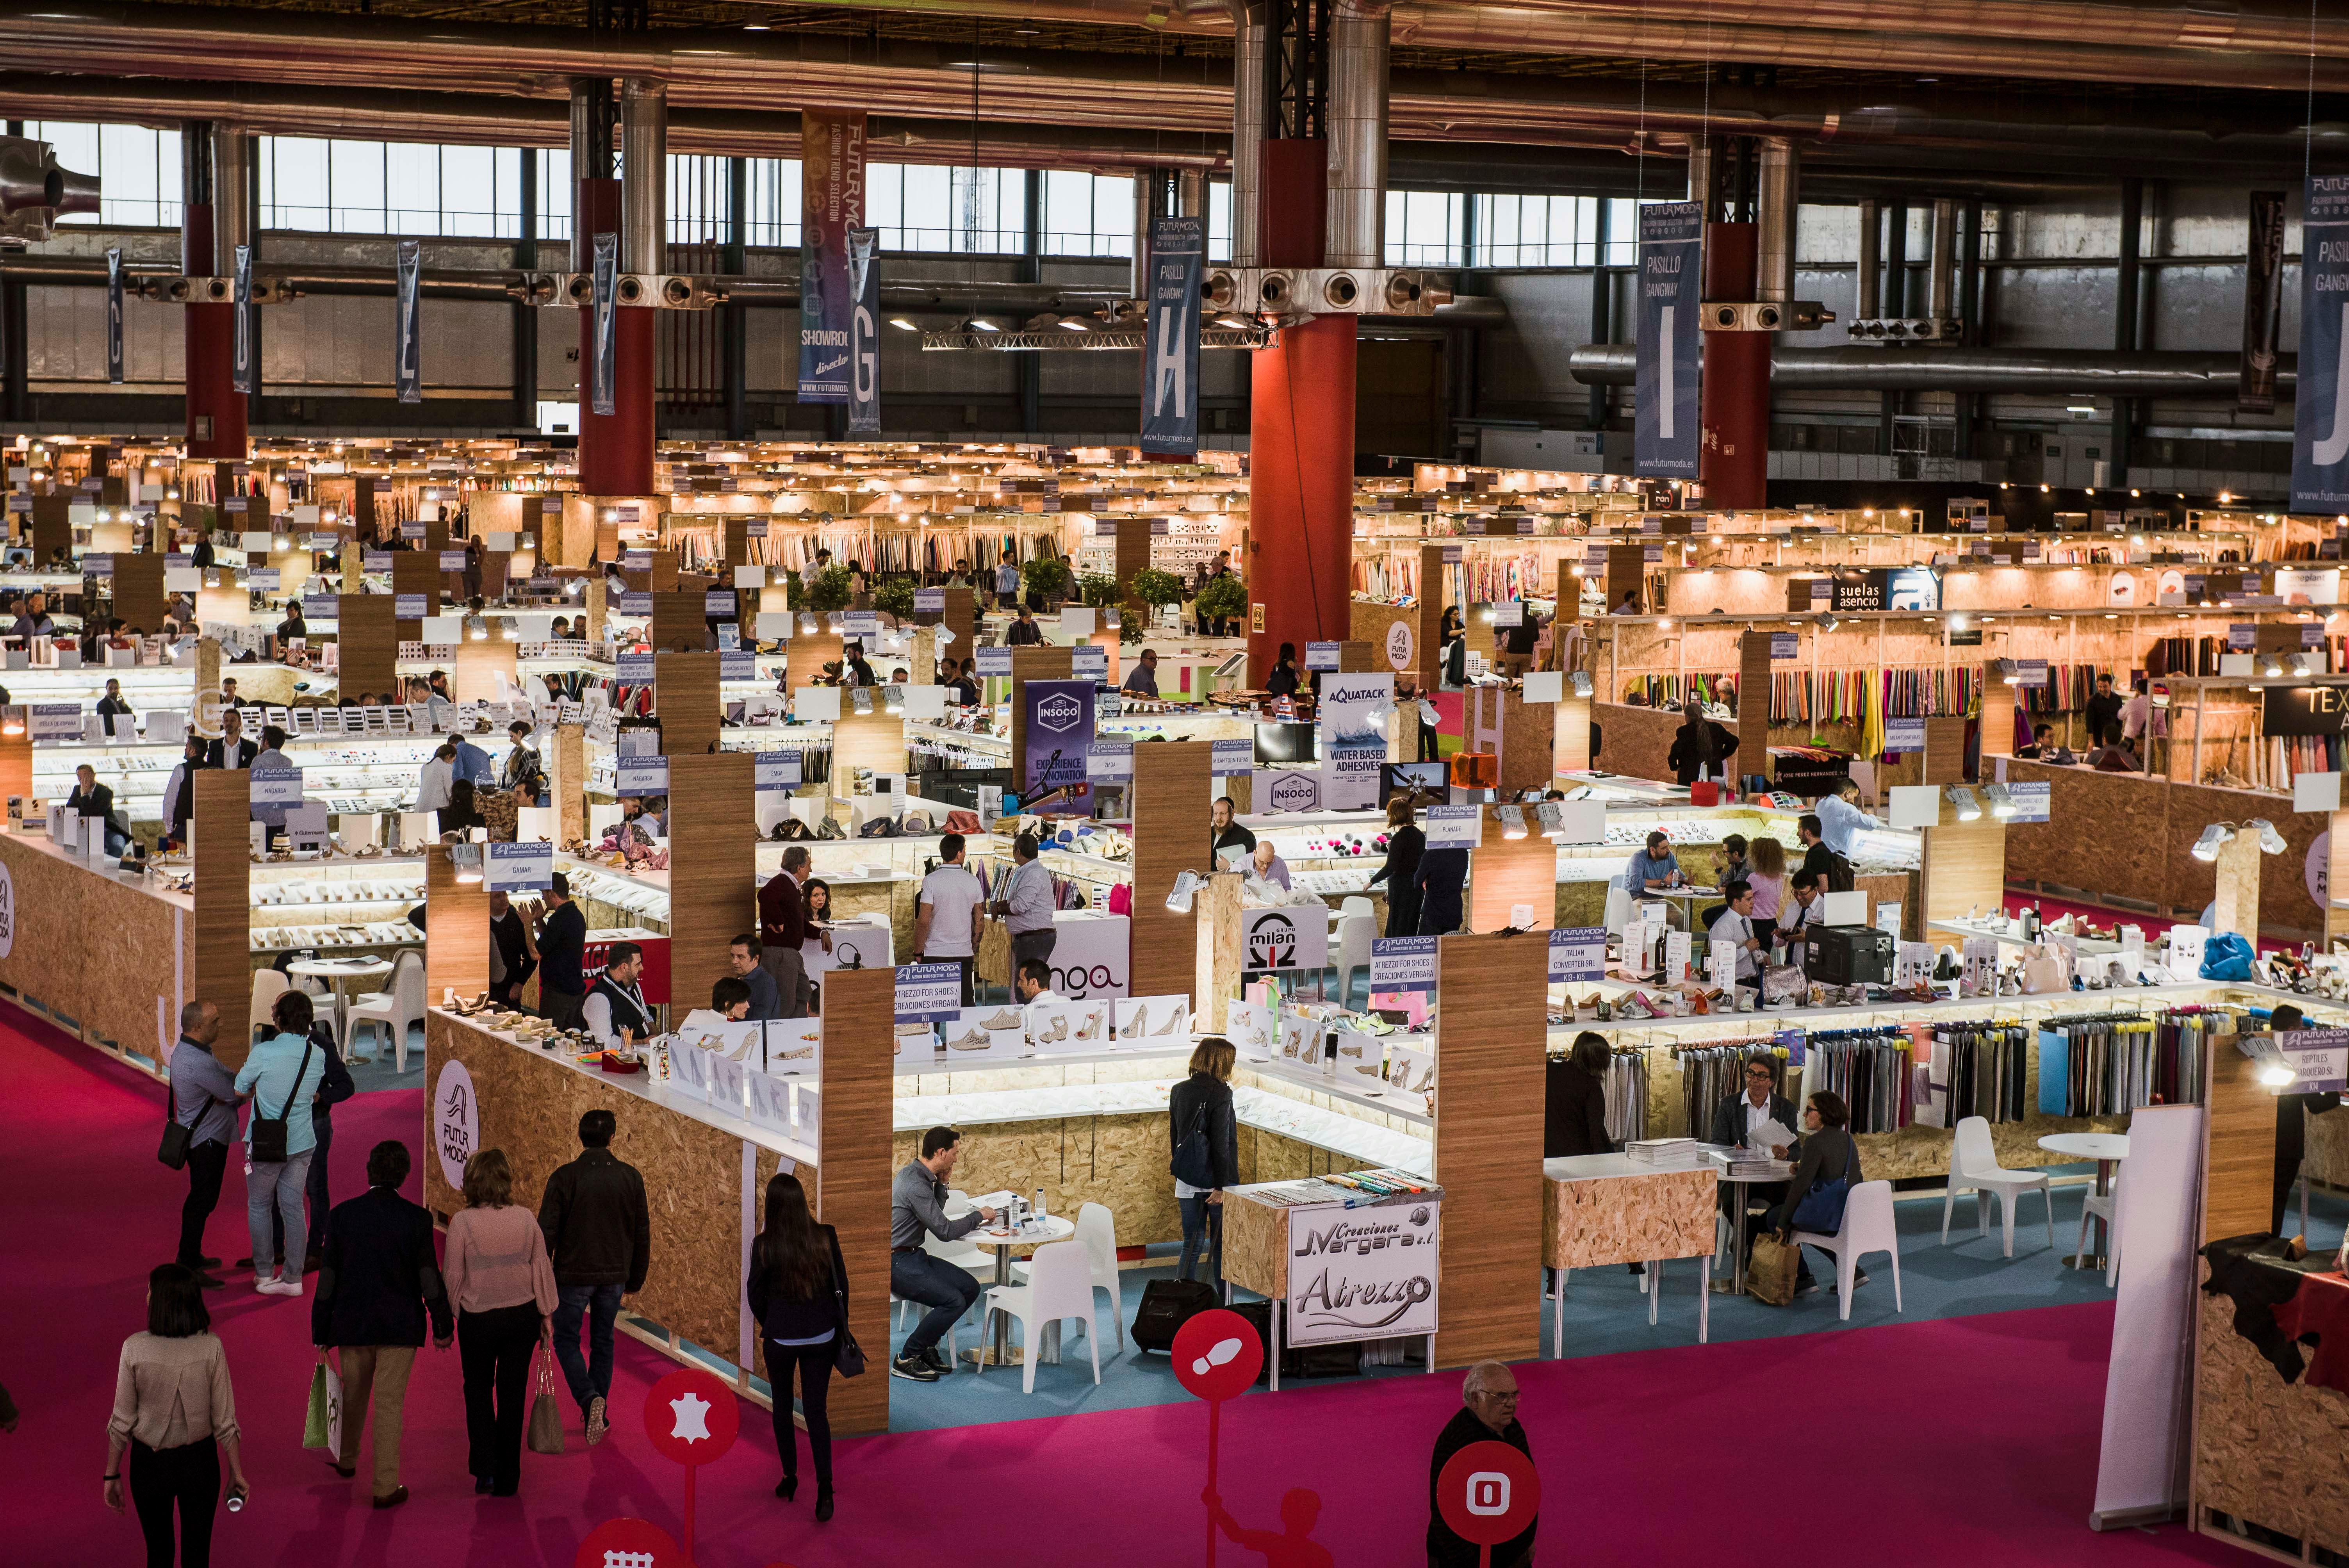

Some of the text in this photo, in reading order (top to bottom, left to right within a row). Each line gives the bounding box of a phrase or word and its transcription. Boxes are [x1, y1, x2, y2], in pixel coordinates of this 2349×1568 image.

[829, 123, 841, 222] FASHION TREND SELECTION
[1644, 204, 1701, 217] FUTURMODA
[1159, 222, 1200, 233] FUTURMODA
[1647, 256, 1681, 274] PASILLO
[1160, 265, 1184, 280] PASILLO
[1158, 287, 1184, 299] GANGWAY
[1646, 283, 1677, 297] GANGWAY
[801, 330, 848, 347] SHOWRO
[854, 306, 874, 402] G
[1154, 306, 1187, 418] H
[1660, 306, 1674, 438] I
[1143, 433, 1193, 443] www.futurmoda.es
[1640, 458, 1694, 468] www.futurmoda.es
[1840, 583, 1879, 596] suelas
[1840, 597, 1878, 606] asencio
[1392, 645, 1407, 654] FUTUR
[1329, 687, 1385, 703] AQUATACK
[1041, 708, 1077, 717] INSOCO
[1330, 750, 1386, 761] WATER BASED
[1036, 758, 1082, 770] EXPERIENCE
[1336, 761, 1381, 772] ADHESIVES
[1274, 789, 1313, 799] INSOCO
[1250, 932, 1296, 945] milan
[1391, 937, 1435, 946] FUTURMODA
[911, 964, 960, 974] FUTURMODA
[1375, 960, 1399, 969] ATREZZO
[1554, 960, 1584, 969] CONVERTER
[1374, 971, 1433, 980] CREACIONES VERGARA
[894, 989, 920, 998] ATREZZO
[935, 987, 954, 996] SHOES
[894, 1000, 958, 1010] CREACIONES VERGARA
[2302, 1030, 2348, 1039] FUTURMODA
[2302, 1054, 2328, 1064] REPTILES
[2327, 1066, 2333, 1075] SL
[444, 1123, 470, 1151] FUTUR
[444, 1142, 468, 1164] MODA
[1335, 1222, 1399, 1240] Creaciones
